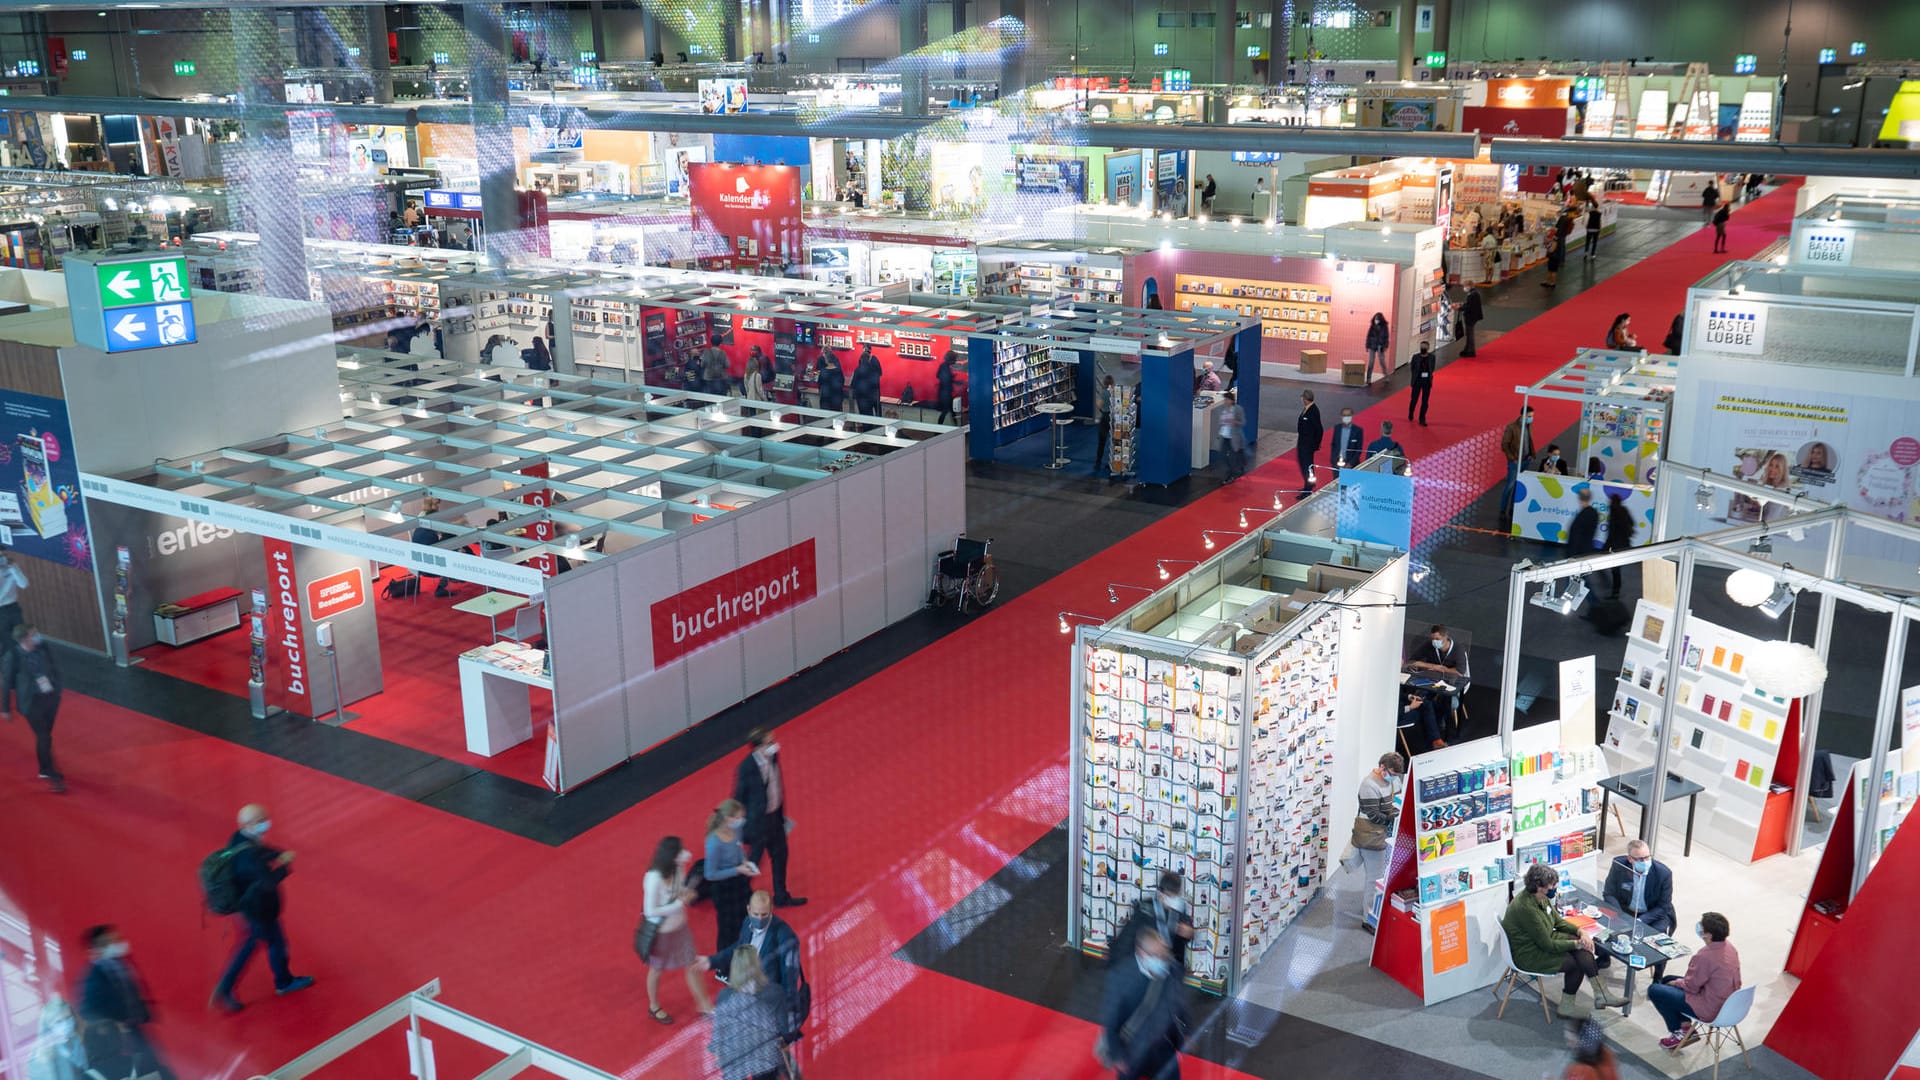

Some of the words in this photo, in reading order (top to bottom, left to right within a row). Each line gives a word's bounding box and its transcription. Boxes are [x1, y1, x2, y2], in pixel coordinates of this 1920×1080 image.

[1117, 176, 1130, 185] WAS
[1808, 241, 1845, 251] BASTEI
[1708, 319, 1755, 333] BASTEI
[1732, 405, 1777, 415] BESTSELLERS
[452, 562, 487, 575] HARENBERG
[488, 568, 540, 586] KOMMUNIKATION
[320, 581, 351, 597] SPIEGEL
[318, 591, 356, 609] Bestseller
[671, 566, 800, 643] buchreport
[273, 551, 305, 695] buchreport
